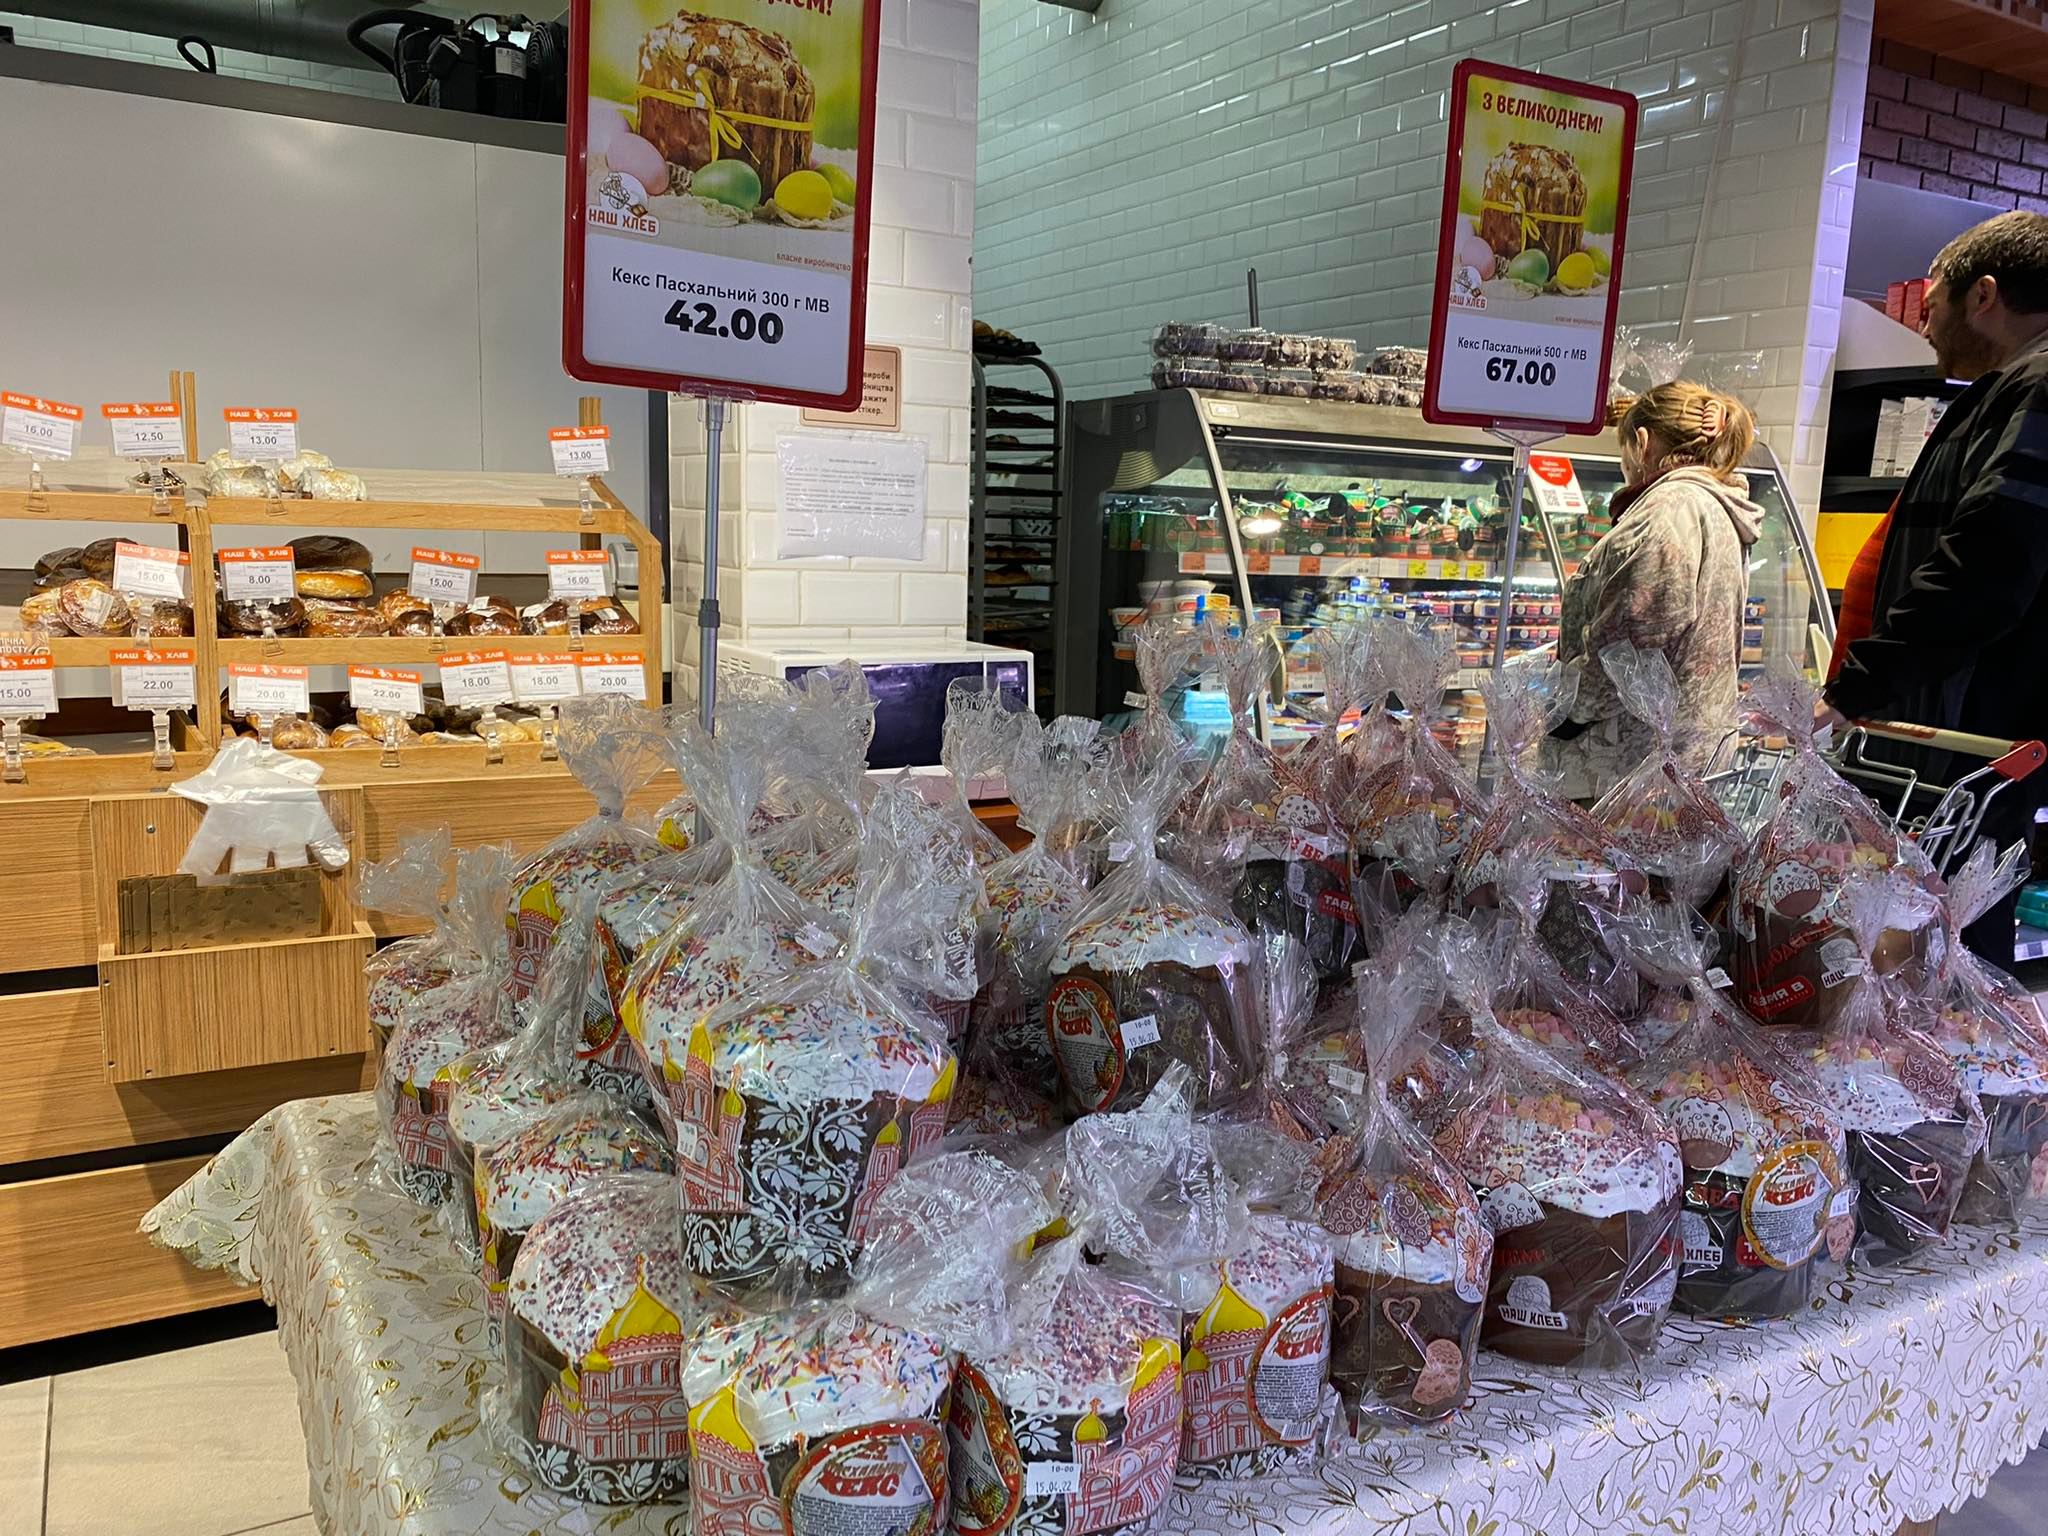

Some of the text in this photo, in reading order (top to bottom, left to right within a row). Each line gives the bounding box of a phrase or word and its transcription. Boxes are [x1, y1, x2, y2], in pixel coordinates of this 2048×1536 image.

[1483, 92, 1604, 134] З ВЕЛИКОДНЕМ!
[588, 208, 656, 232] НАШ ХЛЕБ
[612, 267, 830, 313] Кекс Пасхальний 300 г МВ
[1466, 298, 1486, 309] ХЛЕБ
[664, 299, 784, 345] 42.00
[1457, 336, 1587, 360] Кекс Пасхальний 500 г МВ
[1486, 356, 1556, 386] 67.00
[863, 382, 894, 393] бництва
[863, 395, 887, 403] ажити
[25, 424, 53, 437] 16.00
[135, 432, 164, 442] 12.50
[250, 436, 277, 445] 13.00
[569, 450, 592, 459] 13.00
[137, 570, 165, 583] 15.00
[248, 575, 271, 584] 8.00
[429, 576, 453, 588] 15.00
[143, 680, 174, 690] 22.00
[462, 676, 490, 688] 18.00
[531, 675, 559, 686] 18.00
[600, 676, 627, 687] 20.00
[0, 688, 31, 698] 15.00
[256, 689, 285, 699] 20.00
[372, 688, 401, 699] 22.00
[1686, 1248, 1721, 1263] ХЛЕБ
[1501, 1307, 1563, 1327] НАШ ХЛЕБ
[1050, 1465, 1074, 1473] 10-00
[818, 1474, 900, 1497] КЕКС
